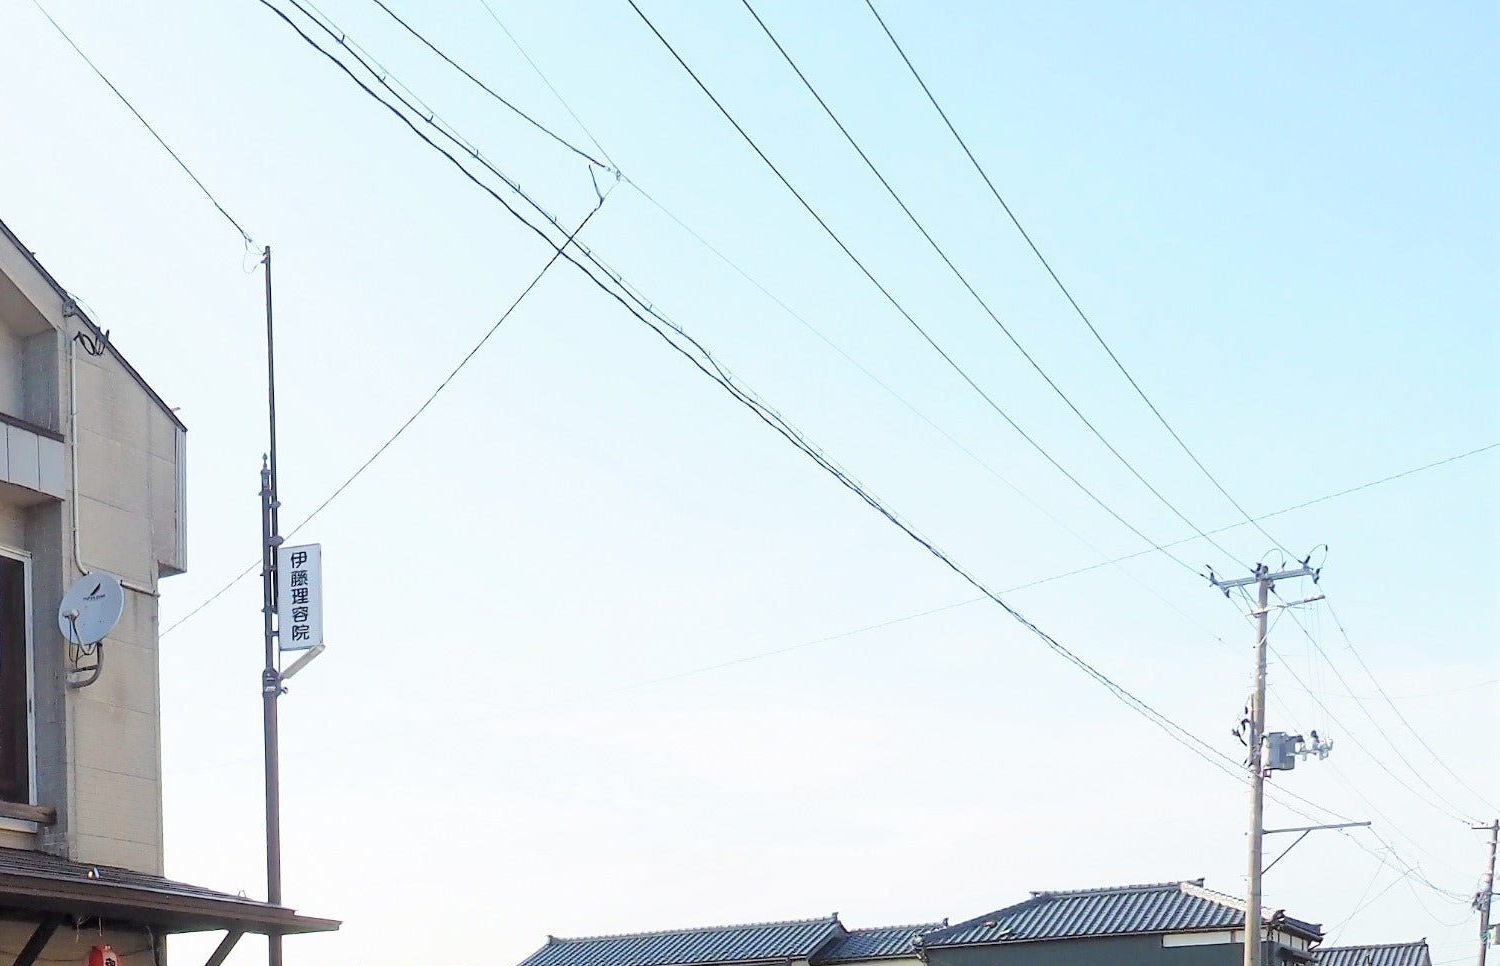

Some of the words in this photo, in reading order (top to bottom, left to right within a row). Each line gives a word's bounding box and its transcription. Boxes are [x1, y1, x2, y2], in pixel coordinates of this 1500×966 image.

[290, 551, 310, 641] 伊藤理容院
